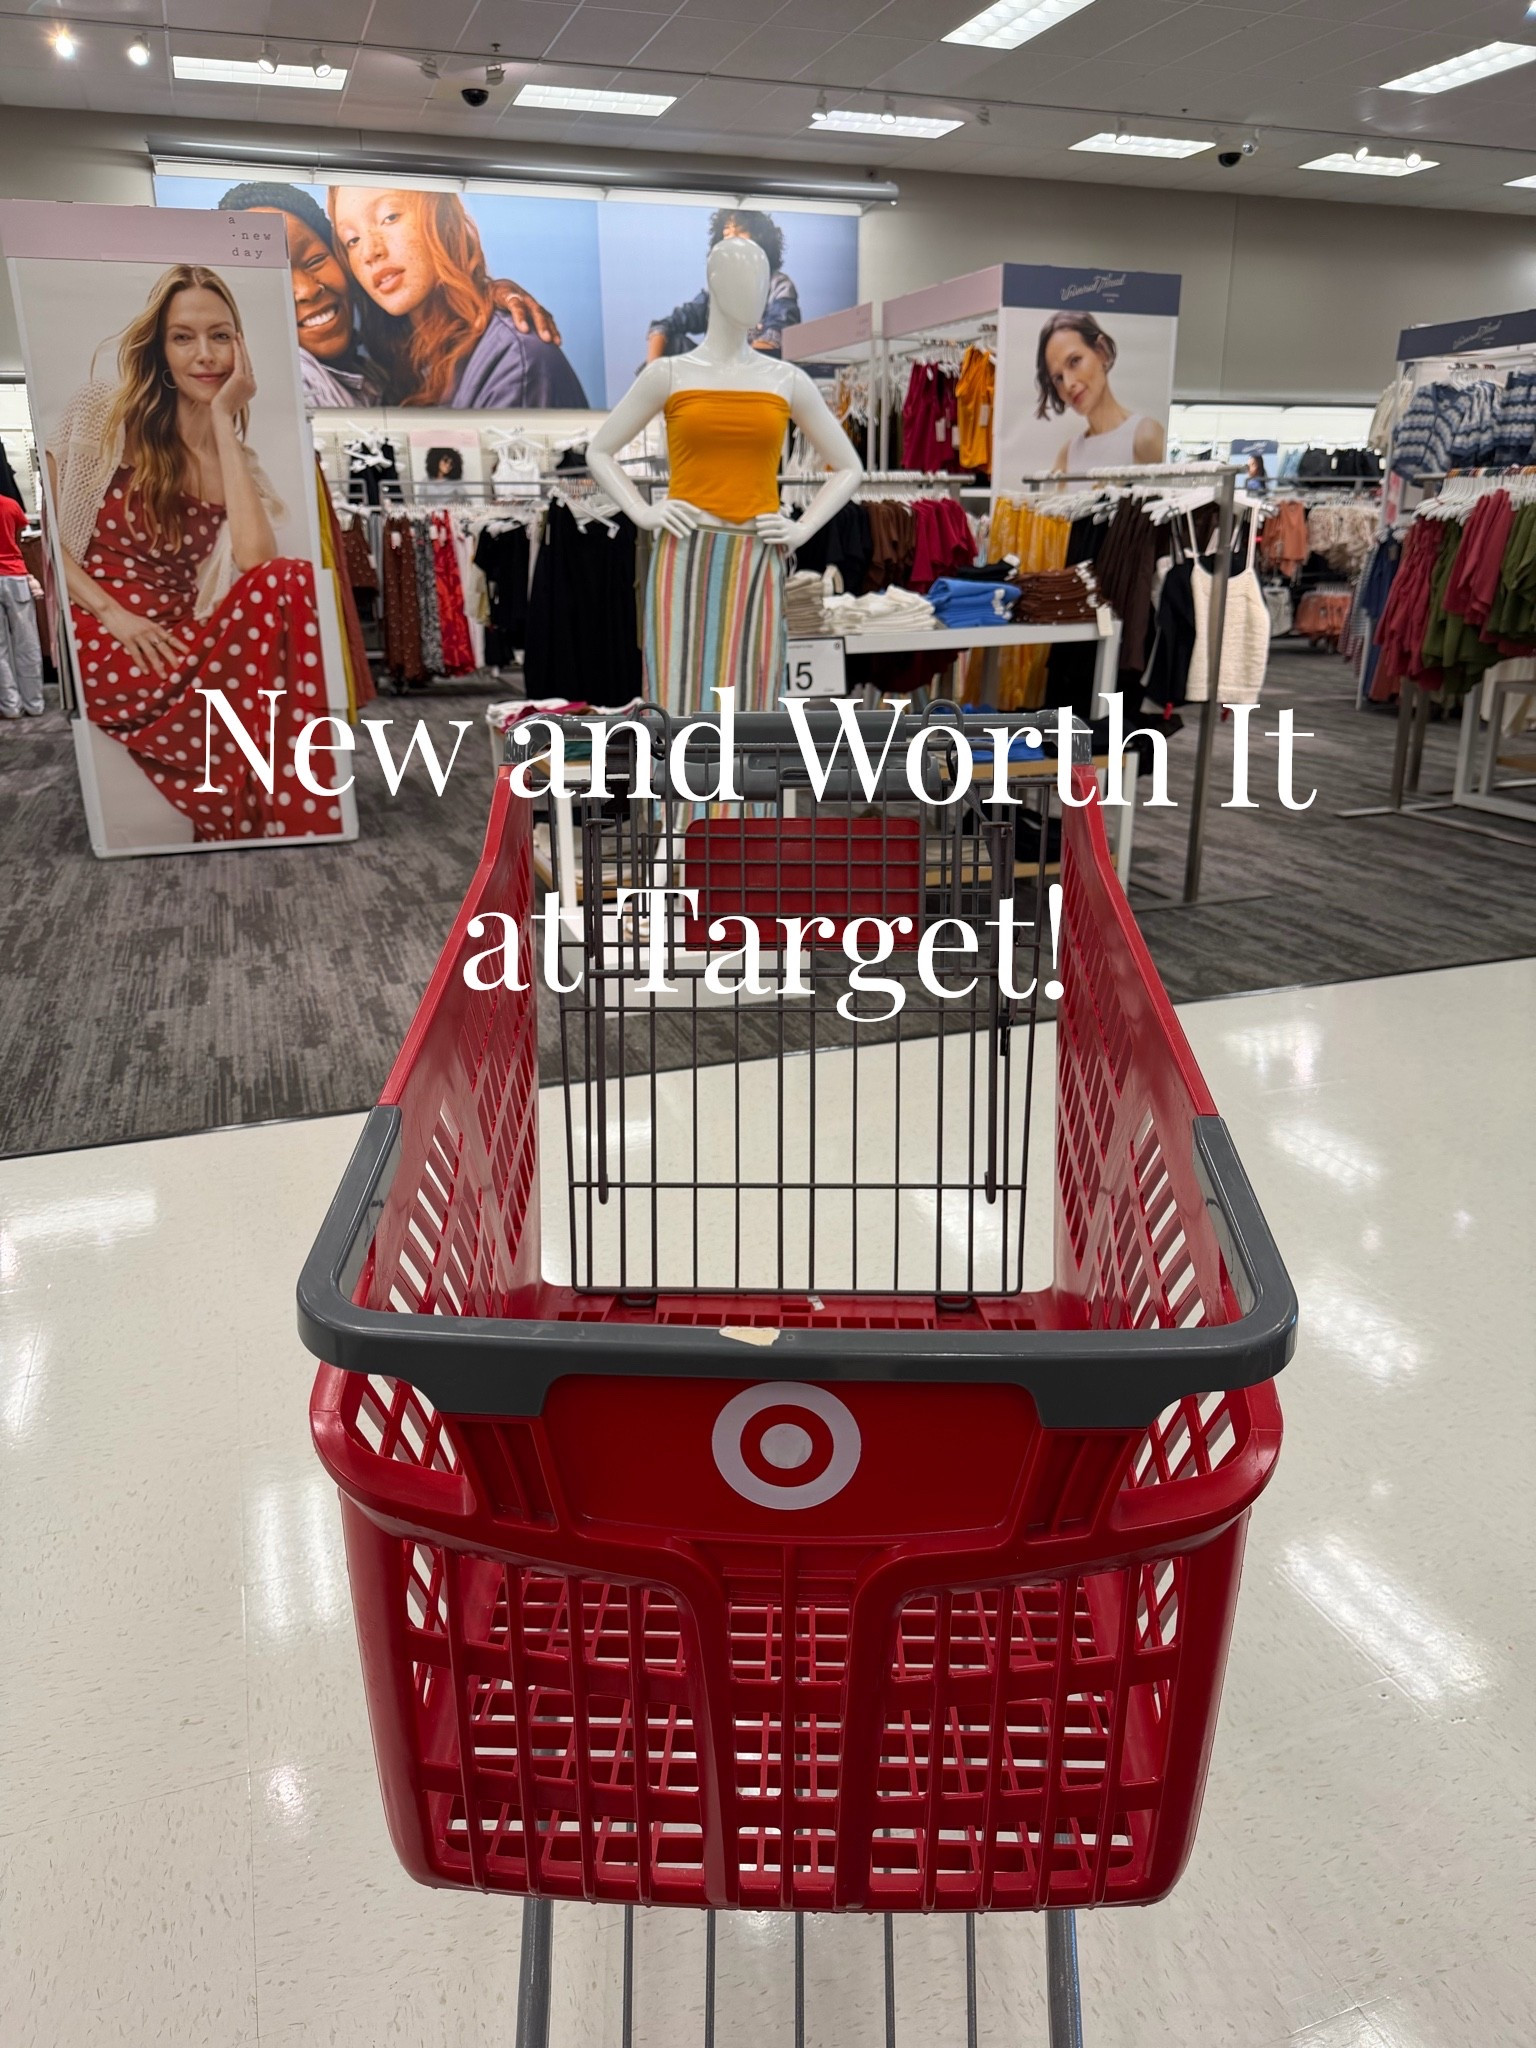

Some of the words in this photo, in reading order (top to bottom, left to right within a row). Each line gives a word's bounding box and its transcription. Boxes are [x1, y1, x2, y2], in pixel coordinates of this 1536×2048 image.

[228, 216, 235, 224] a
[241, 232, 272, 241] new
[232, 247, 263, 260] day
